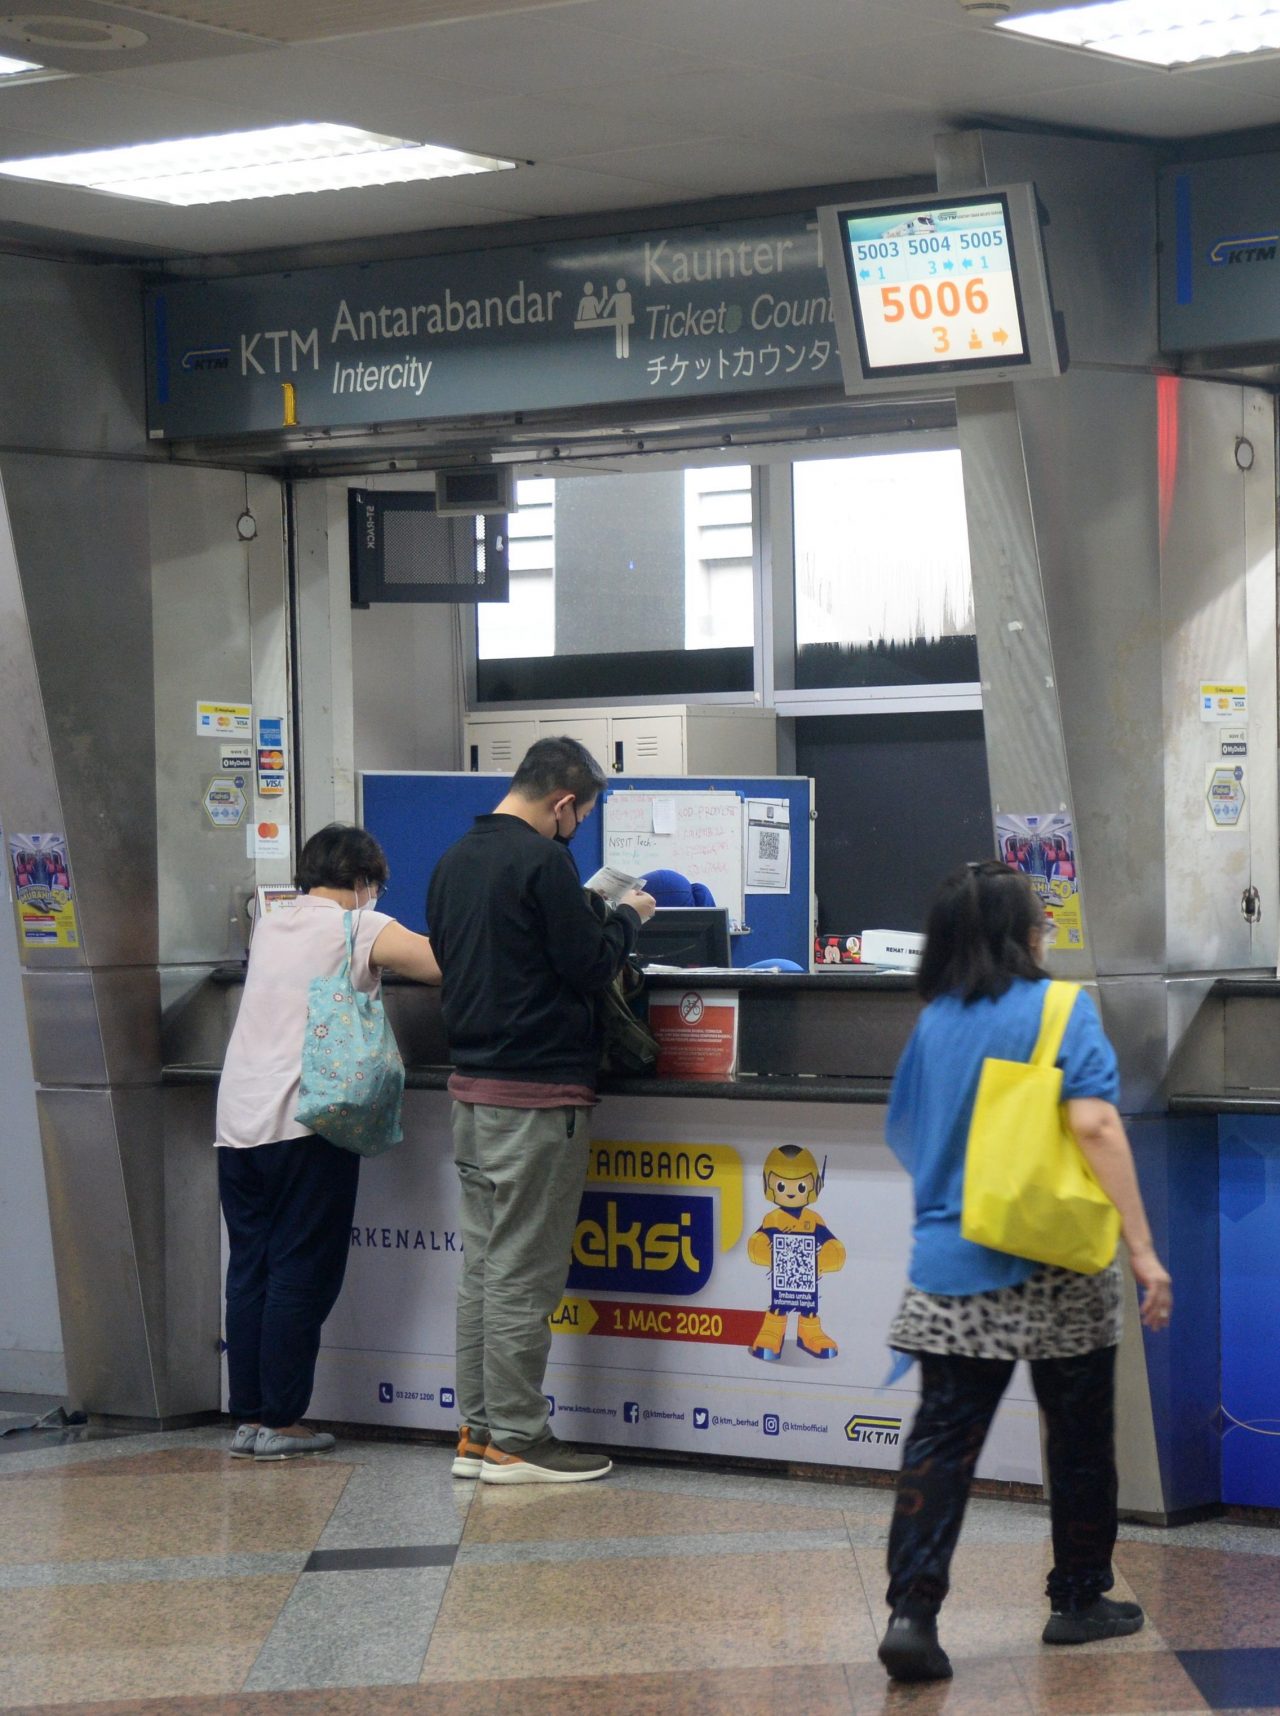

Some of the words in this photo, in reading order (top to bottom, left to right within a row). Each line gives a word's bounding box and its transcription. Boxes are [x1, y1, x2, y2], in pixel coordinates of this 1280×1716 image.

[644, 239, 794, 287] Kaunter
[857, 241, 900, 261] 5003
[908, 236, 951, 255] 5004
[960, 230, 1003, 250] 5005
[1226, 245, 1277, 264] KTM
[332, 282, 563, 343] Antarabandar
[646, 301, 728, 340] Ticket
[751, 293, 836, 331] Count
[880, 277, 989, 323] 5006
[241, 327, 319, 376] KTM
[931, 325, 950, 353] 3
[332, 354, 433, 396] Intercity
[646, 339, 841, 386] チケットカウンタ
[281, 383, 297, 426] 1
[265, 780, 282, 788] VISA
[587, 1148, 715, 1181] AMBANG
[351, 1226, 464, 1252] RKENALK
[571, 1200, 700, 1274] eksi
[613, 1308, 623, 1330] 1
[628, 1308, 672, 1333] MAC
[676, 1313, 723, 1337] 2020
[862, 1429, 900, 1446] KTM
